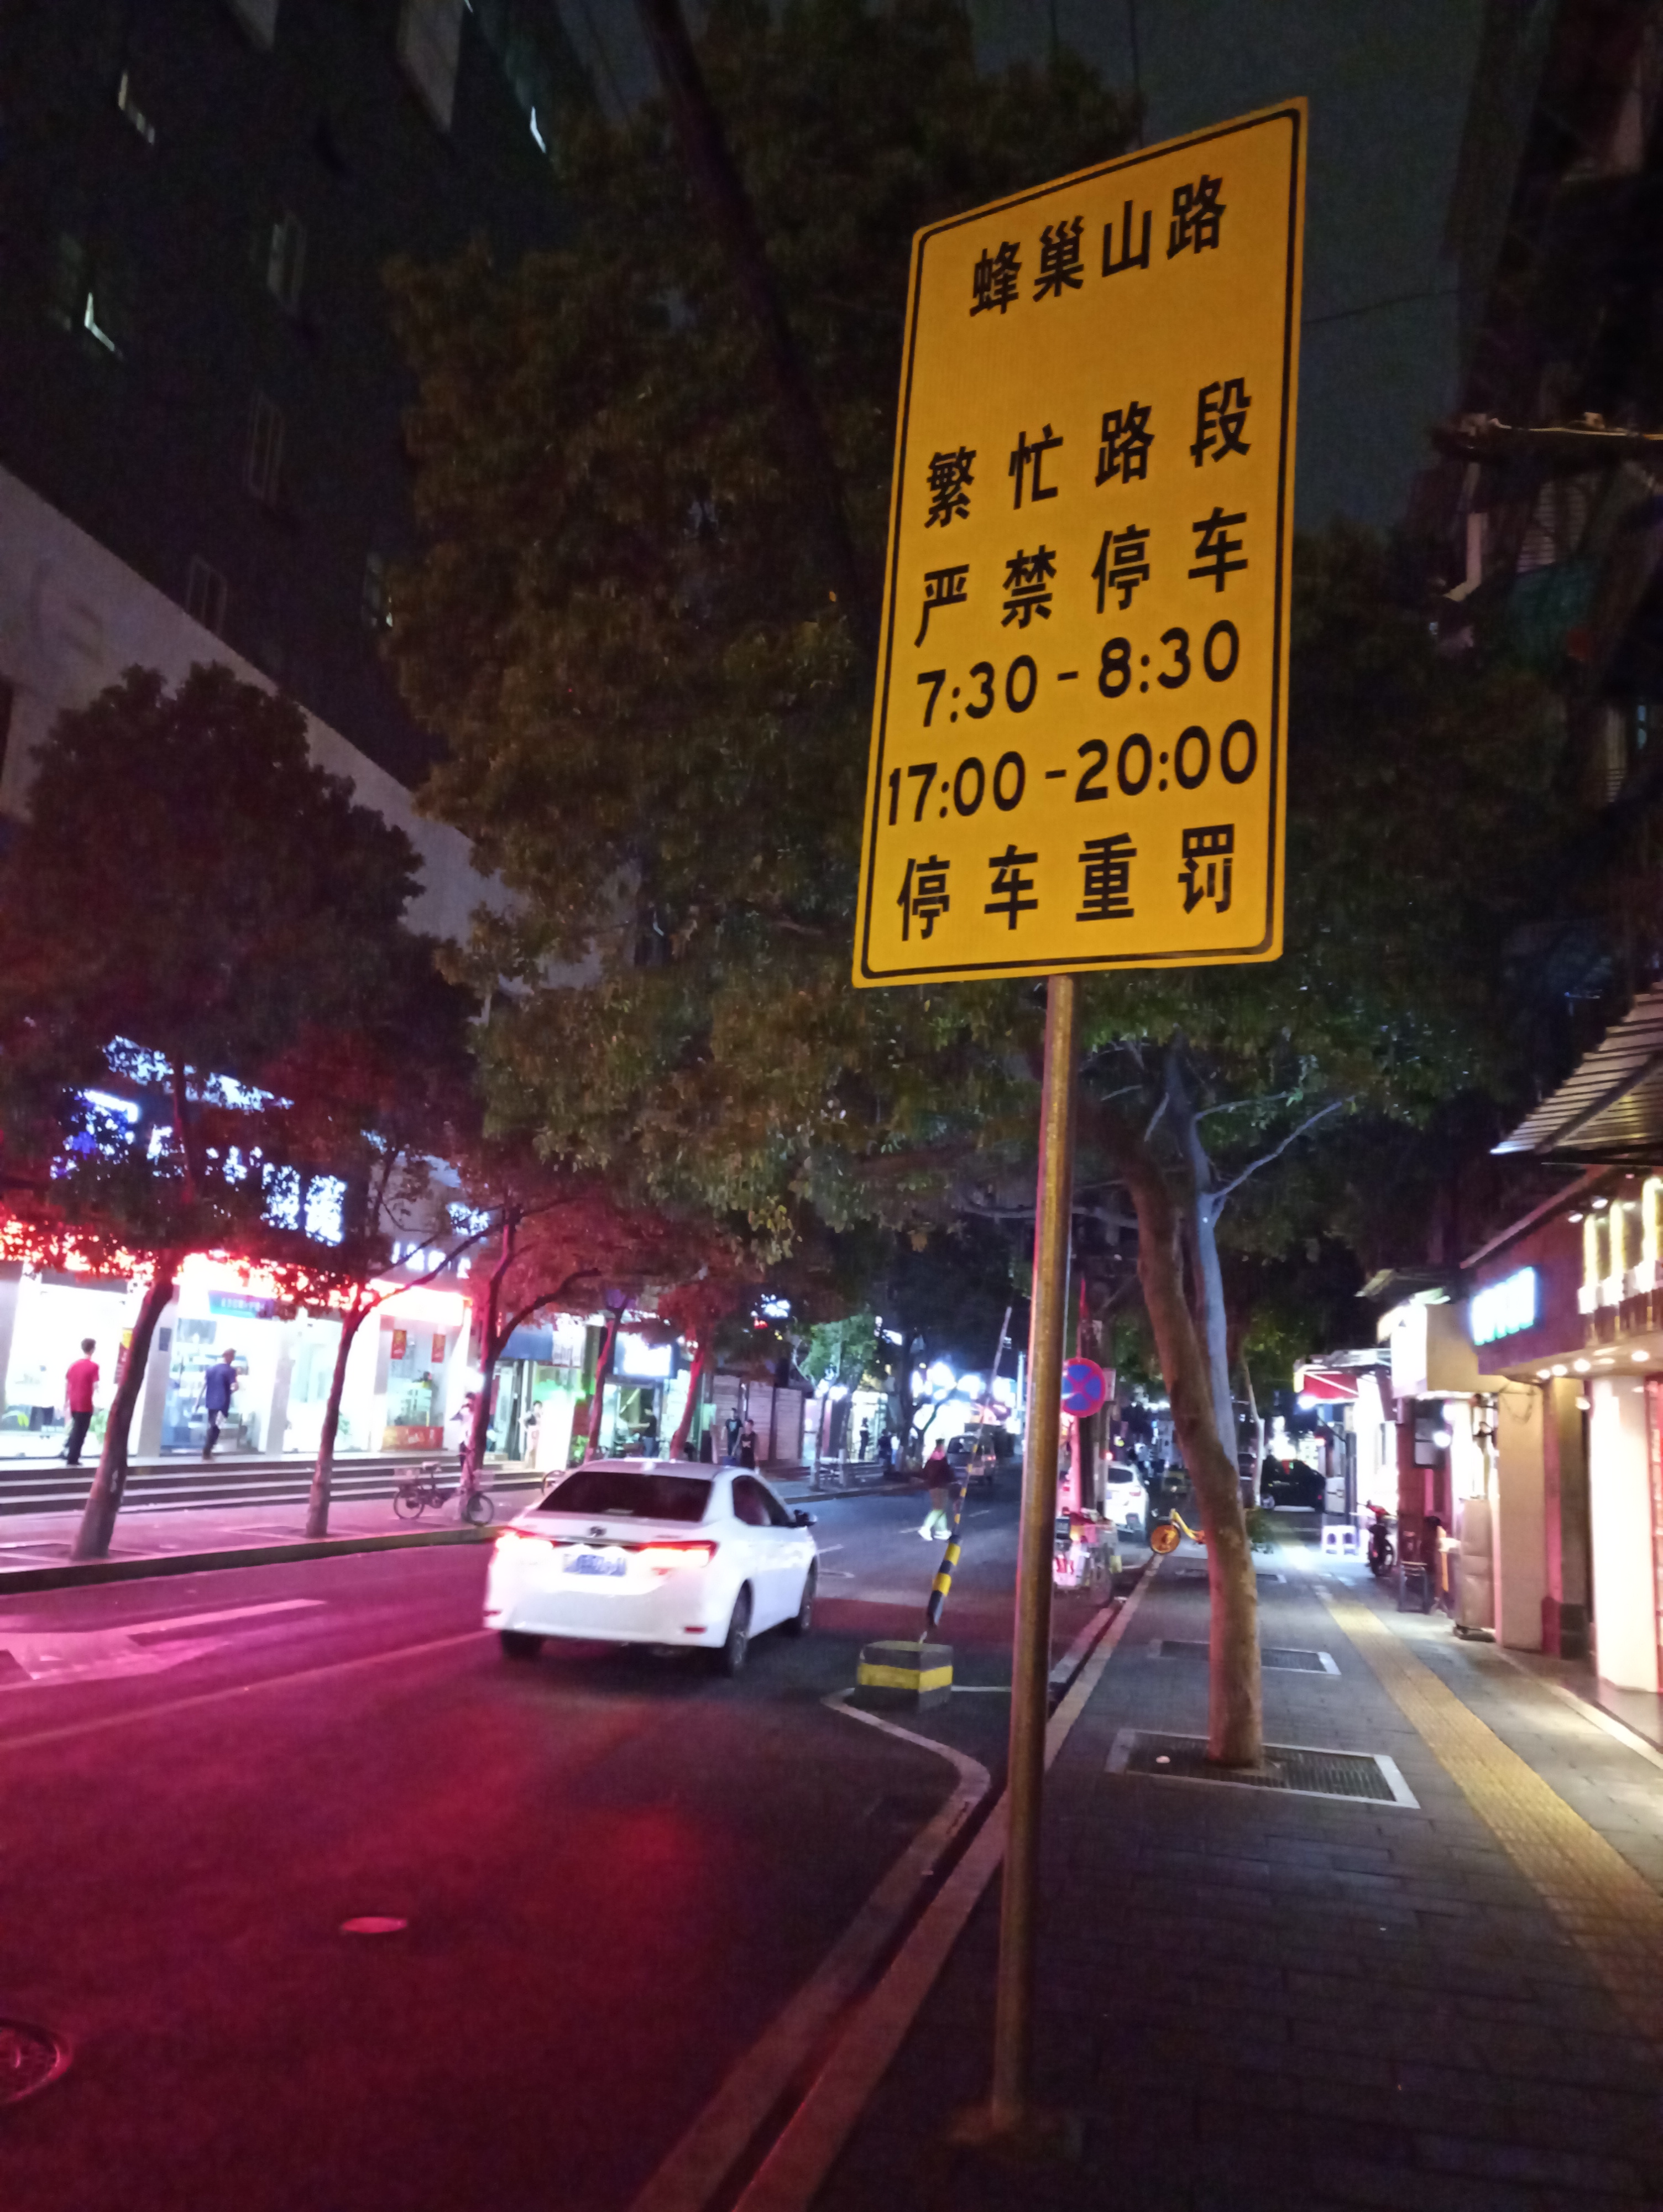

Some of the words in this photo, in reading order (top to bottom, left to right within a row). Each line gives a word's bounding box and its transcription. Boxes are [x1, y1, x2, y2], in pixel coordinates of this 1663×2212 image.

[970, 174, 1227, 317] 蜂巢山路
[924, 377, 1252, 528] 繁忙路段
[914, 507, 1248, 648] 严禁停车
[897, 824, 1235, 941] 停车重罚
